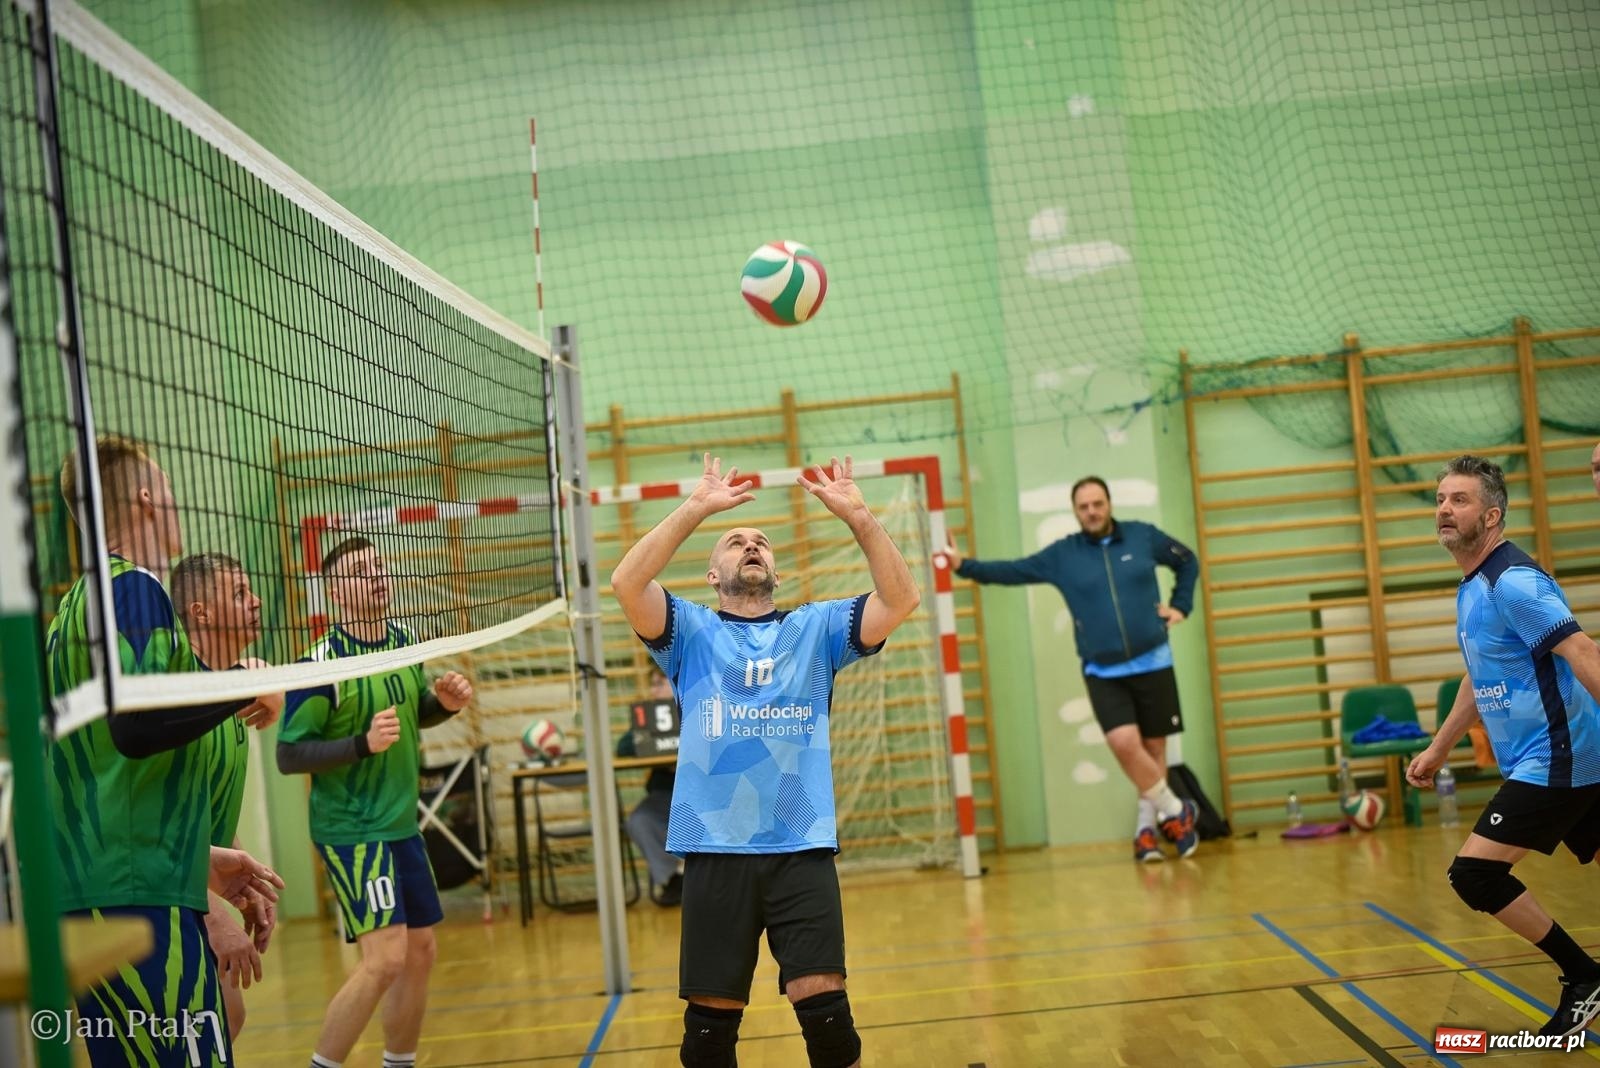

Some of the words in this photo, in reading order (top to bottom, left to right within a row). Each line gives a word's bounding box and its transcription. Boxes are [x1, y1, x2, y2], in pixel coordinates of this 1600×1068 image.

[745, 658, 774, 687] 10
[384, 674, 406, 706] 10
[1474, 681, 1508, 699] ociągi
[655, 704, 673, 732] 5
[730, 702, 812, 721] Wodociągi
[731, 722, 815, 737] Raciborskie
[366, 876, 396, 913] 10
